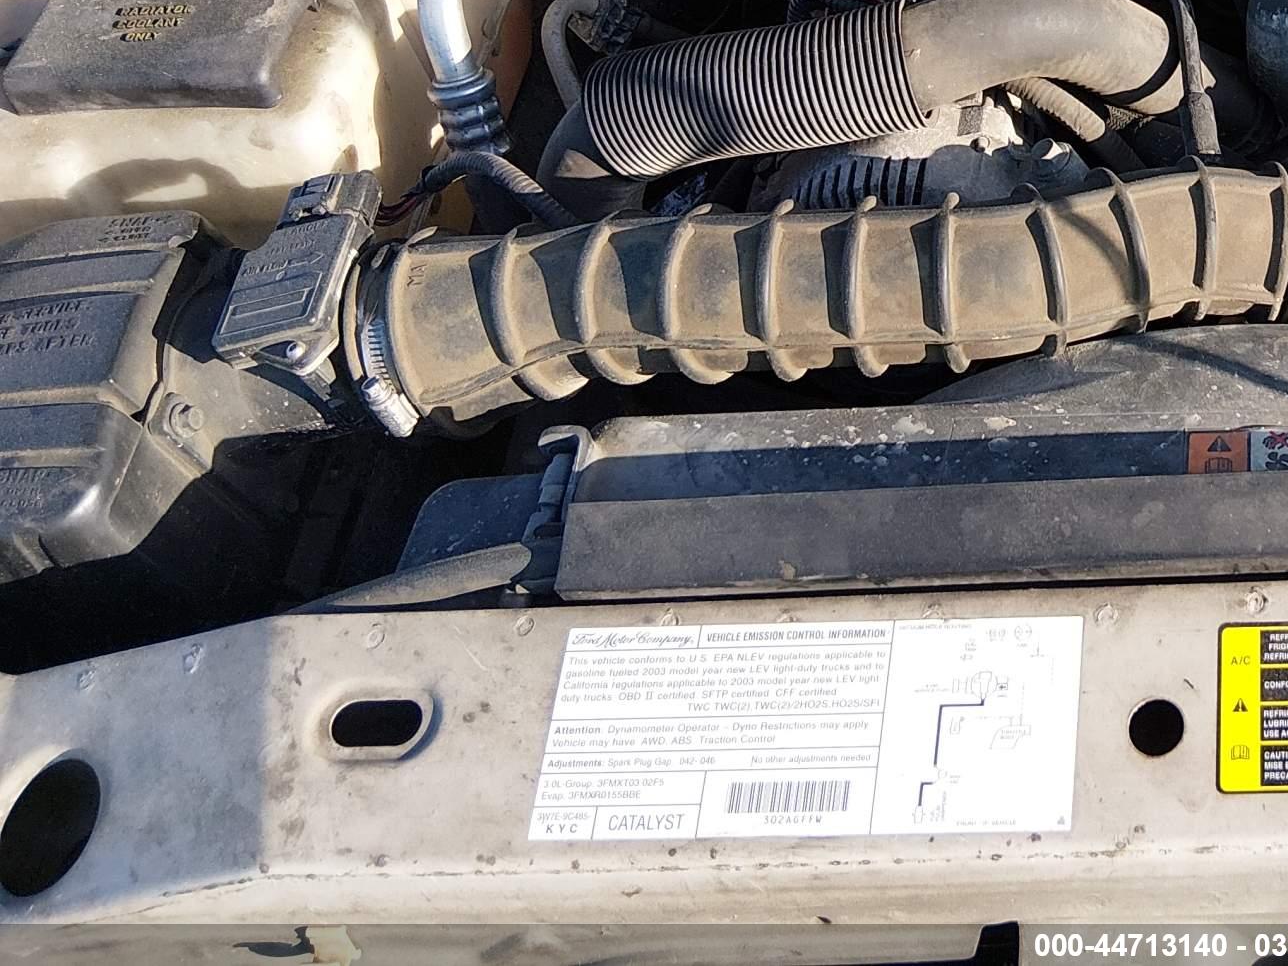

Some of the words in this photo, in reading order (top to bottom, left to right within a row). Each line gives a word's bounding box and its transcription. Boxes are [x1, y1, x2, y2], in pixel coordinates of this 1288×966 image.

[707, 632, 740, 642] VEHICLE
[743, 631, 784, 641] EMISSION
[786, 630, 826, 640] CONTROL
[827, 628, 885, 639] INFORMATION
[1230, 656, 1251, 665] A/C
[607, 814, 686, 830] CATALYST
